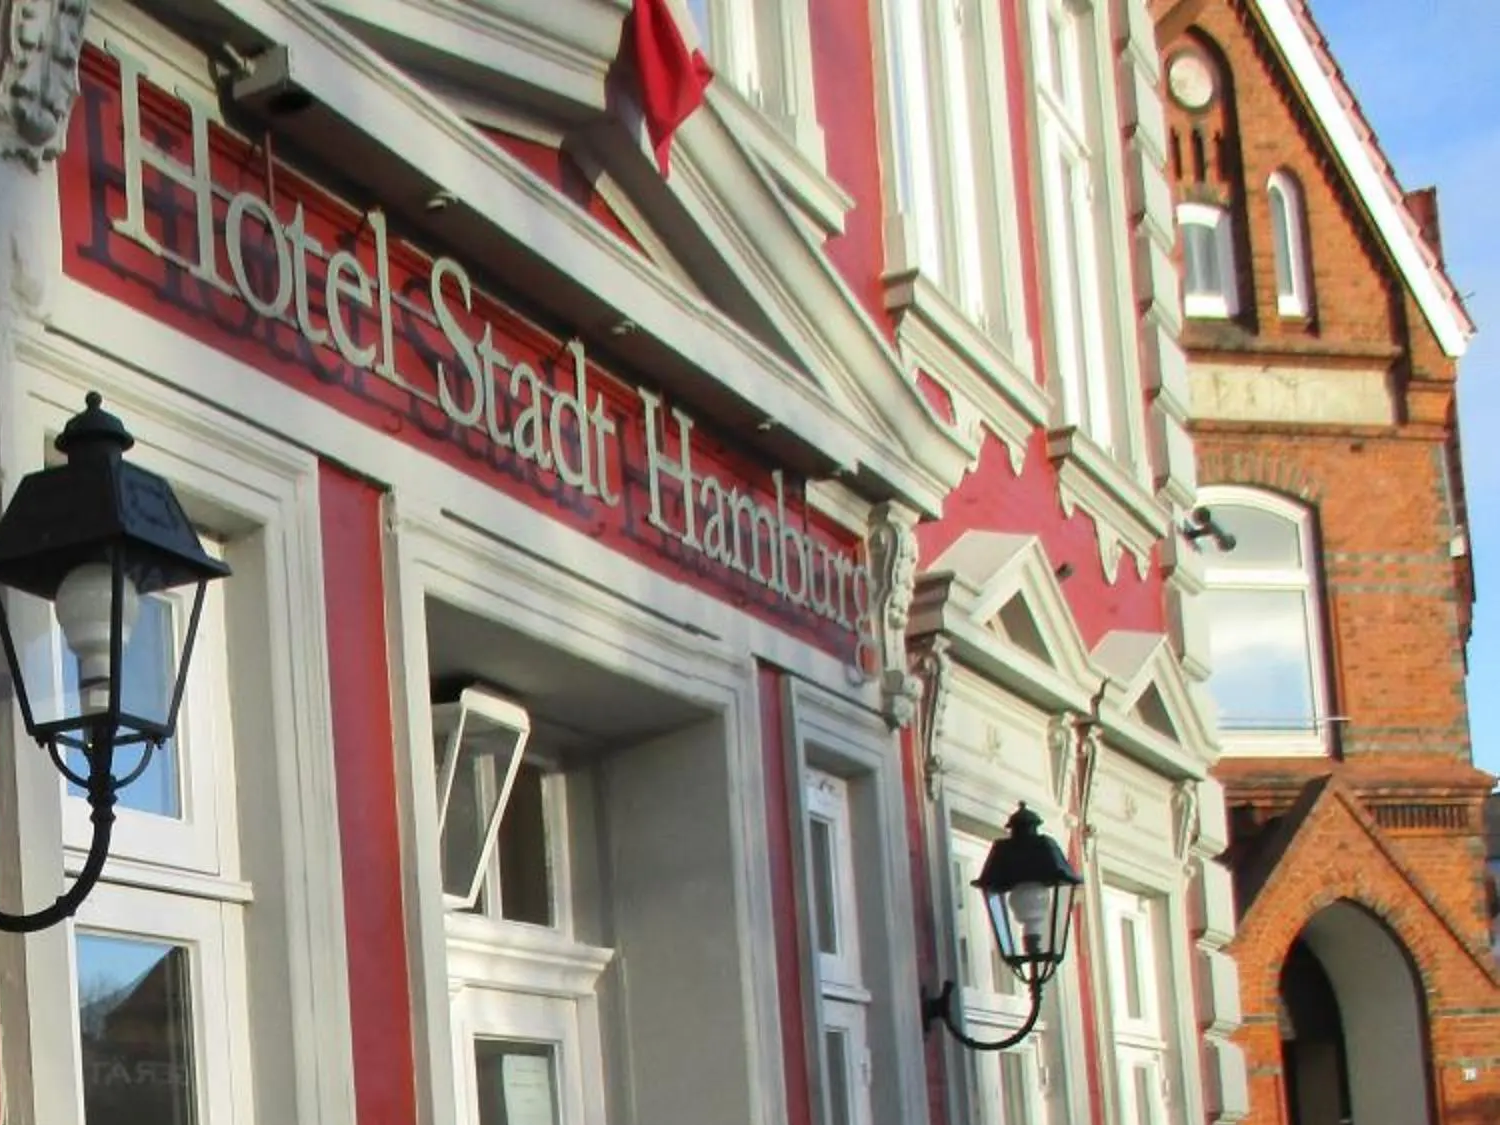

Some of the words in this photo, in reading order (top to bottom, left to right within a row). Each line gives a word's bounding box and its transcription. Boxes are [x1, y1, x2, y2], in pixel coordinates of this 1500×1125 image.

[104, 38, 402, 388] Hotel
[431, 257, 620, 507] Stadt
[637, 386, 879, 682] Hamburg
